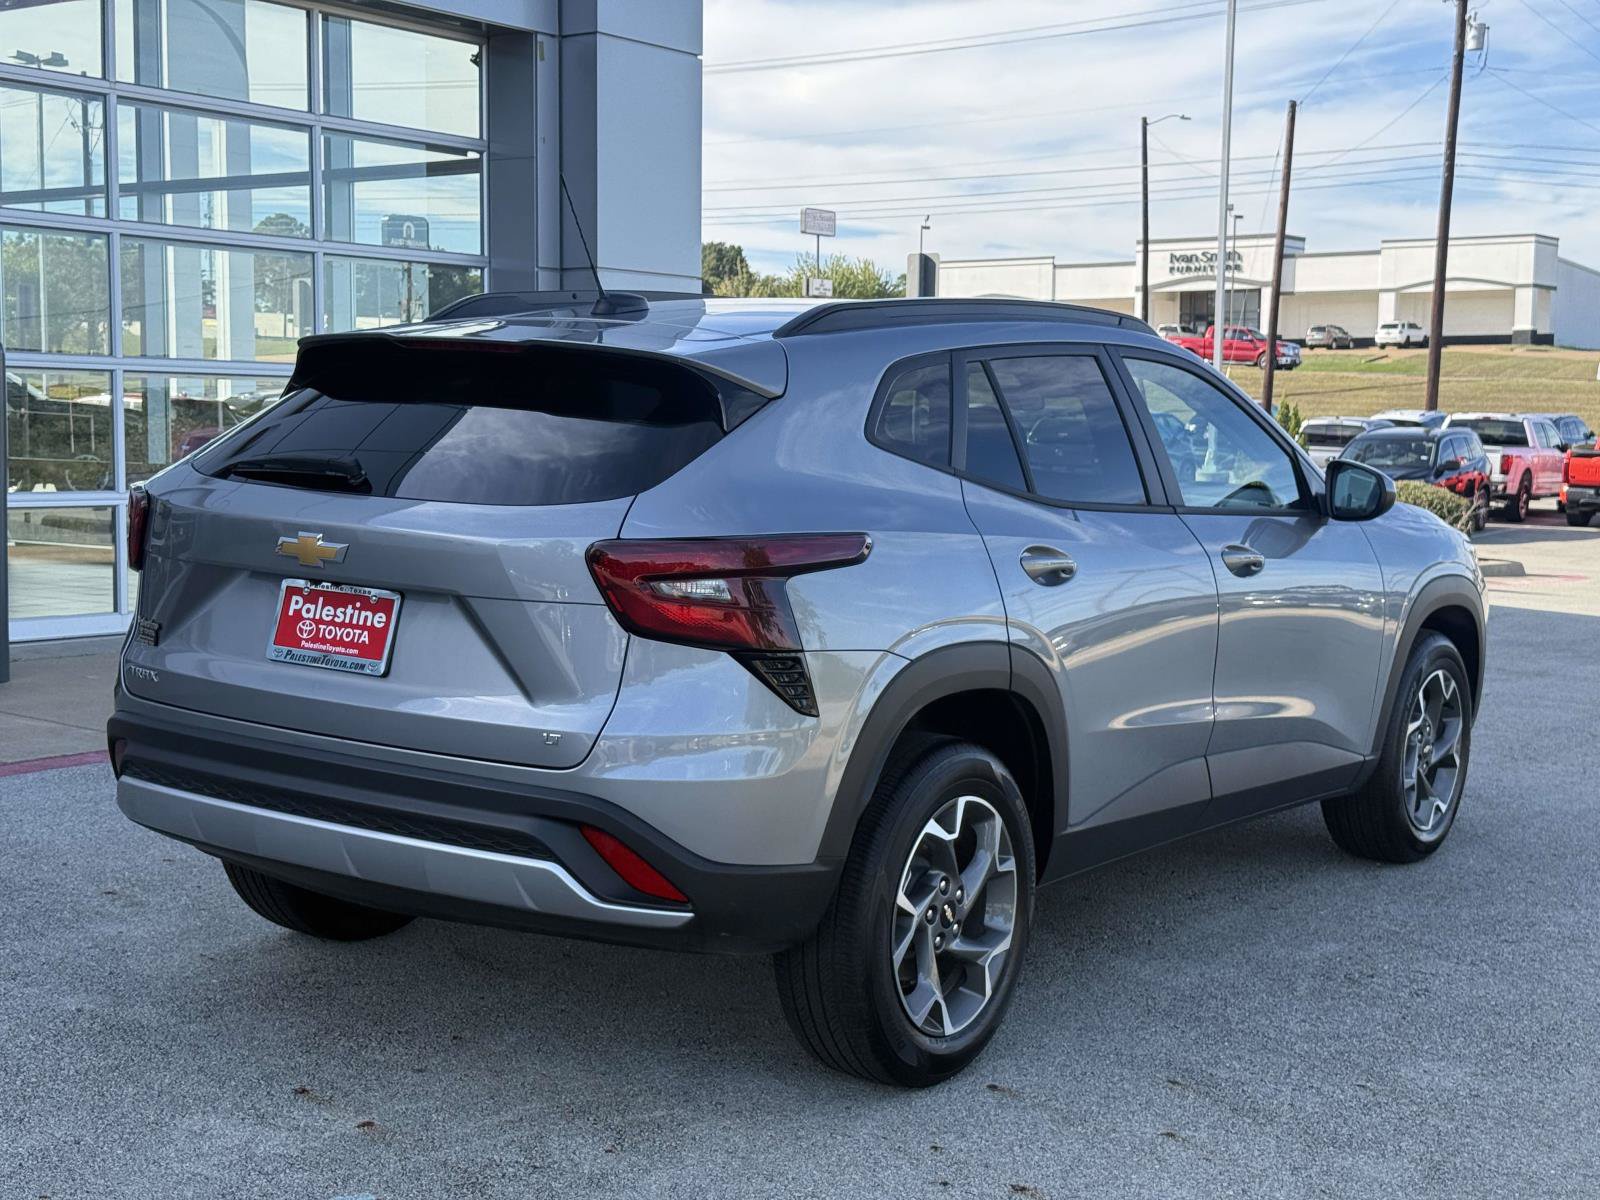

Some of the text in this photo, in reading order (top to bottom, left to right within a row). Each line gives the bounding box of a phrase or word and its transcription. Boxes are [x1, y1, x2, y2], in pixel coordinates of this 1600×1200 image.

[1170, 251, 1243, 263] Ivan Smth
[1169, 264, 1242, 275] FURNITRE
[288, 595, 387, 628] Palestine
[318, 624, 369, 644] TOYOTA
[300, 640, 359, 655] PalestineToyota.com
